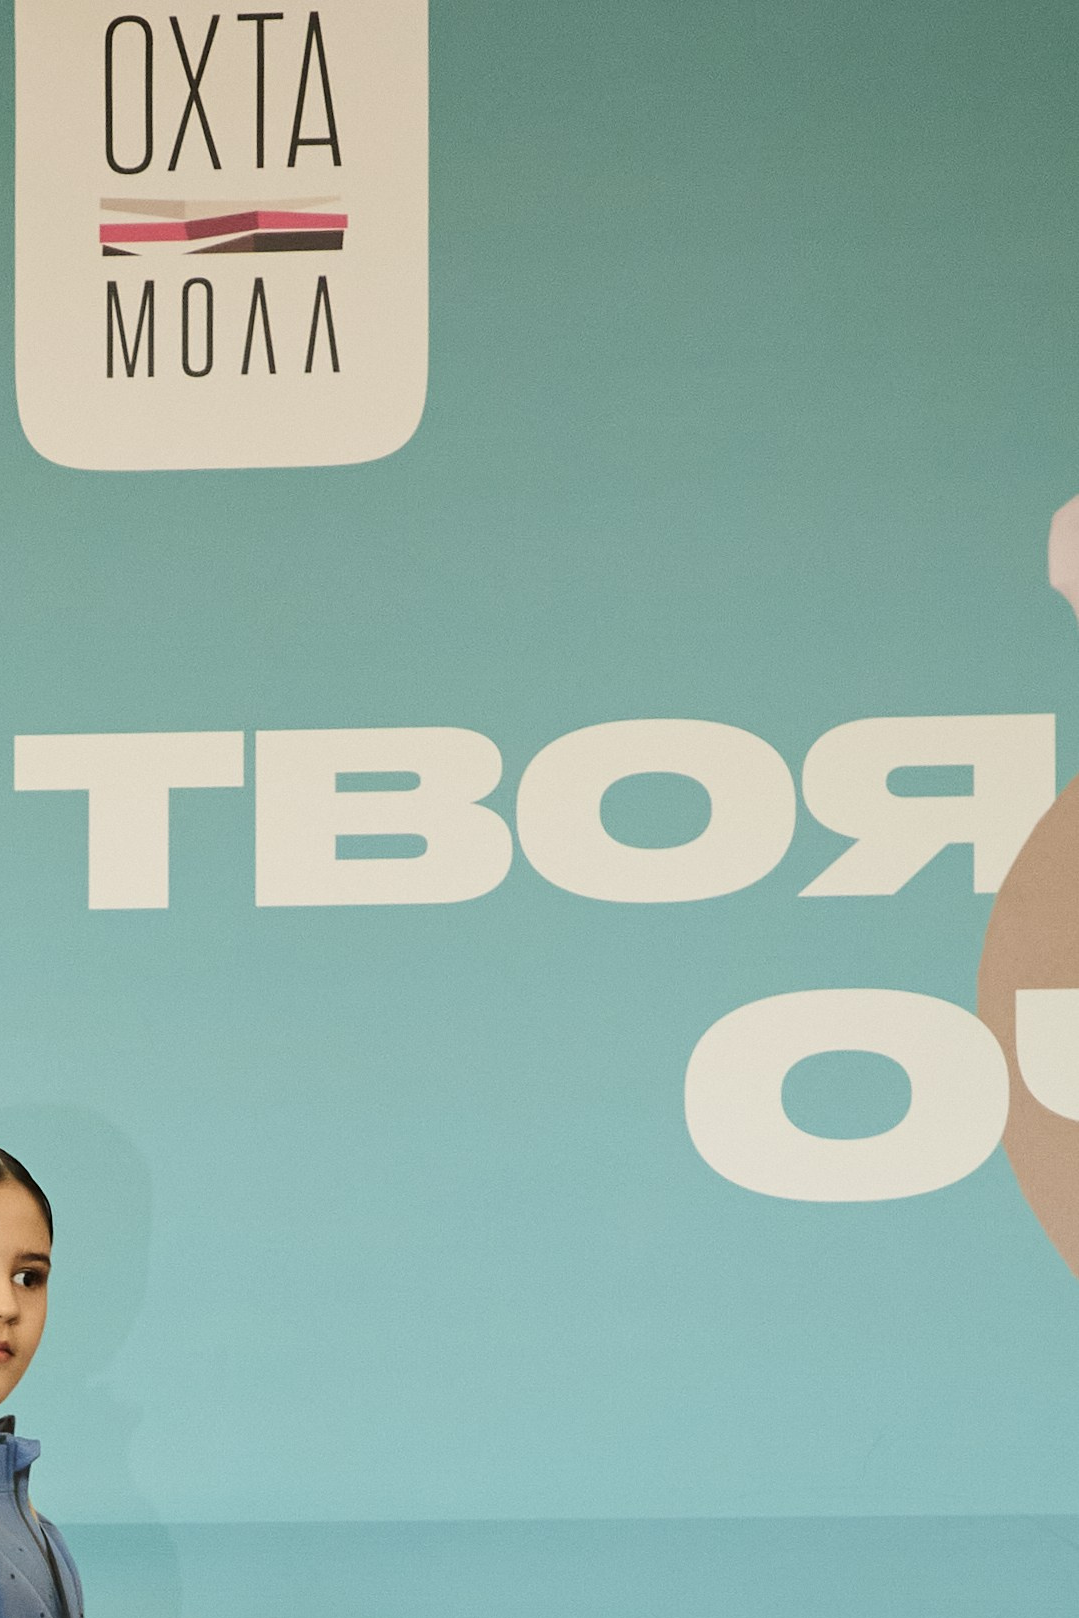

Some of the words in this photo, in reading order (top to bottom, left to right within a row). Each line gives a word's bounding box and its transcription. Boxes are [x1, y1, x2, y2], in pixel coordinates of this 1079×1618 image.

[105, 11, 342, 175] ОХТА
[106, 275, 340, 379] МОЛЛ
[13, 712, 1057, 910] ТВОЯ
[683, 987, 1079, 1203] О
